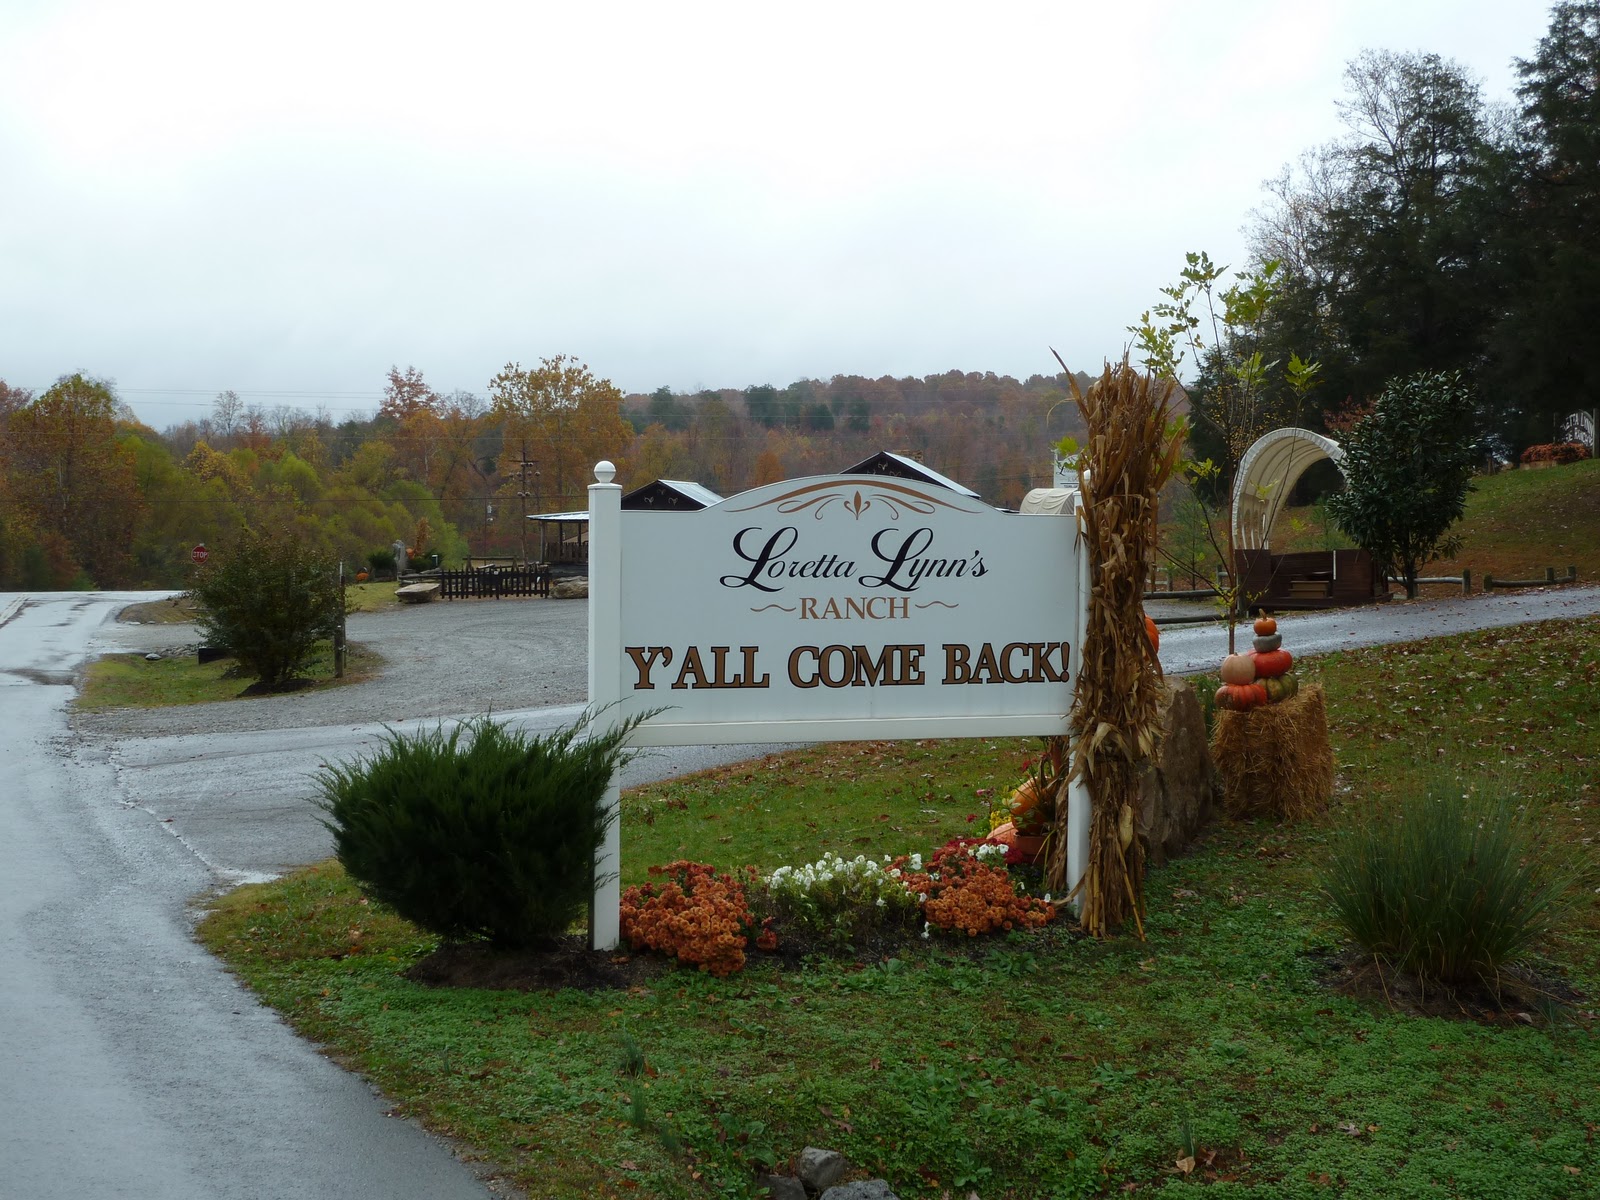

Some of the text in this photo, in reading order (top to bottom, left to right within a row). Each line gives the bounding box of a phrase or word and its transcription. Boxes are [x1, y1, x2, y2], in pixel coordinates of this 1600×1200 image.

[192, 551, 208, 559] STOP
[719, 526, 857, 592] Loretta
[799, 596, 911, 620] RANCH
[787, 644, 925, 688] COME
[941, 641, 1071, 686] BACK!
